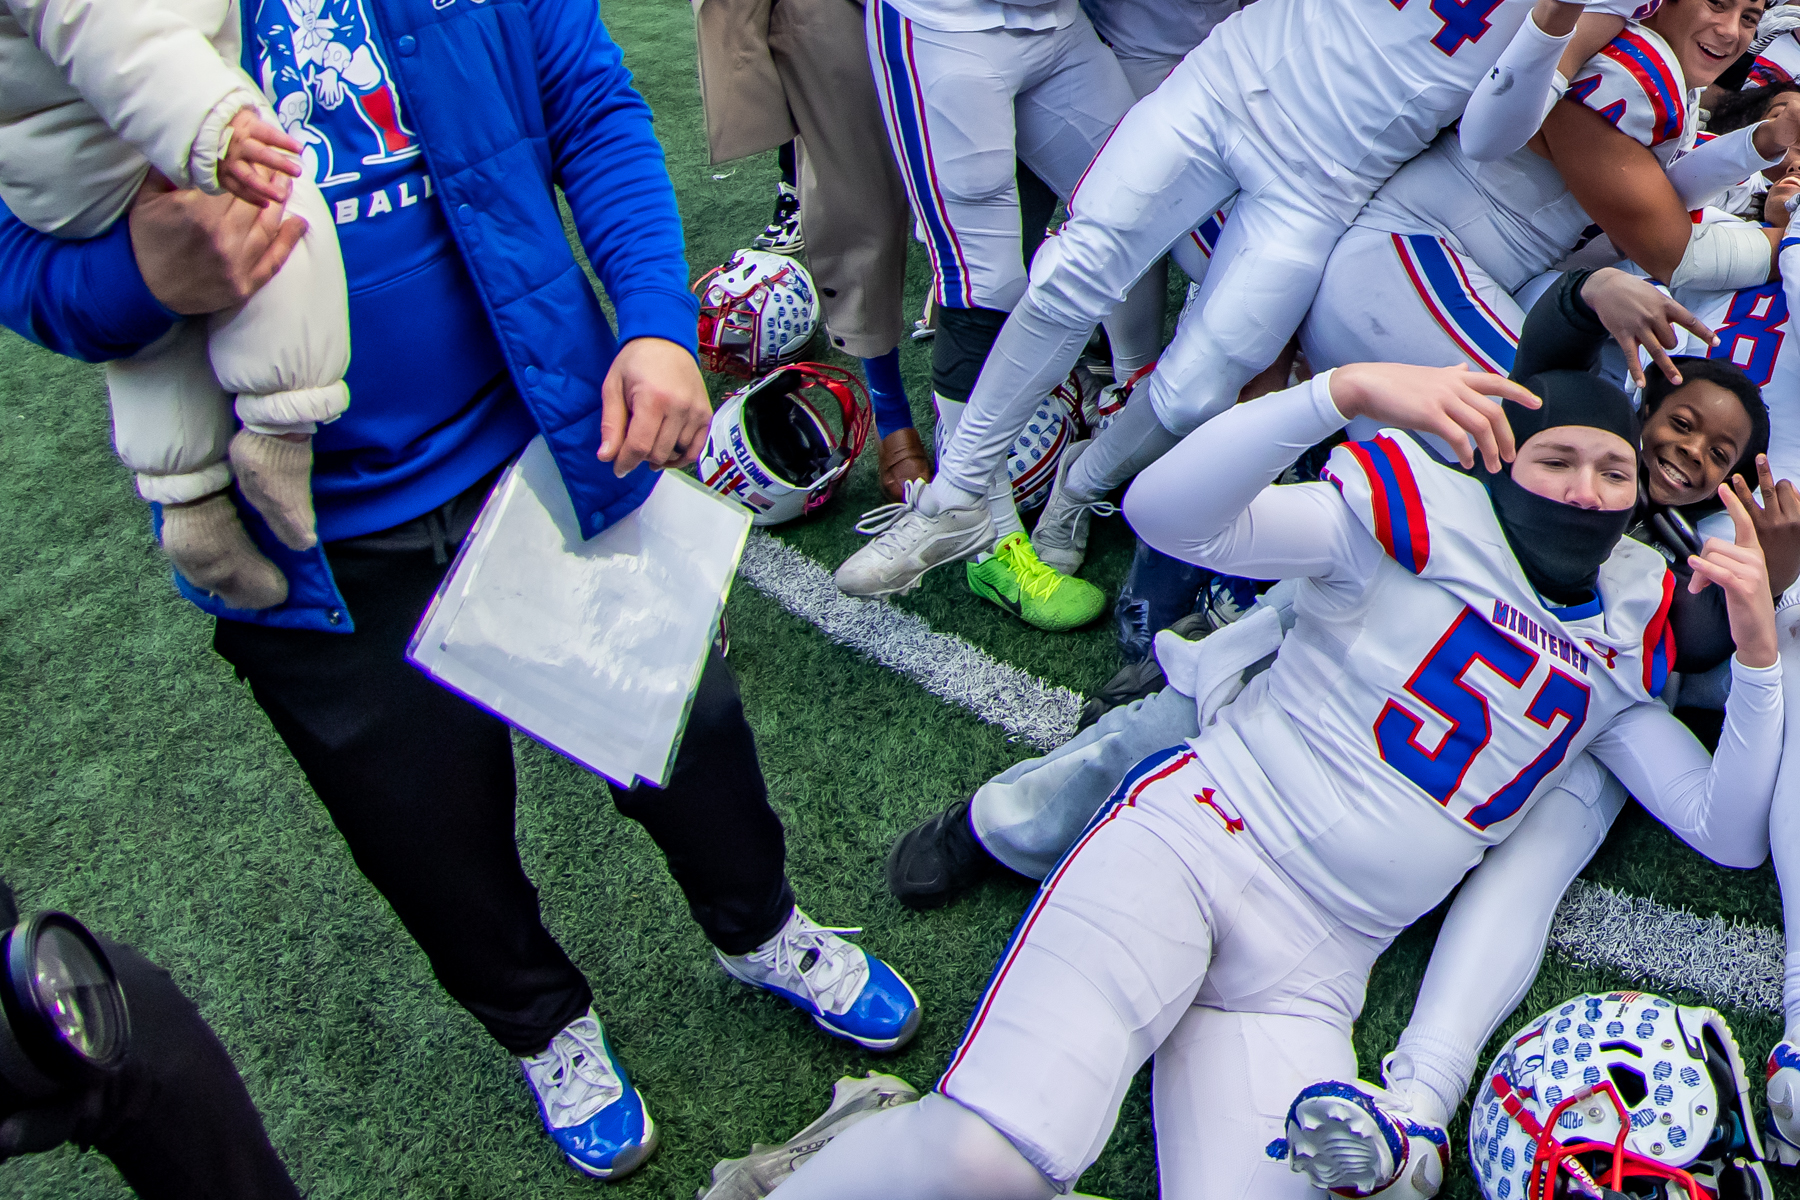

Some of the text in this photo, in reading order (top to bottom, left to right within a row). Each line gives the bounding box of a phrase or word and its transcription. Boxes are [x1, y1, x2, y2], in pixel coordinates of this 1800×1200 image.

[1703, 278, 1791, 388] 8
[1491, 599, 1590, 677] MINUTEMEN
[1372, 604, 1592, 831] 57
